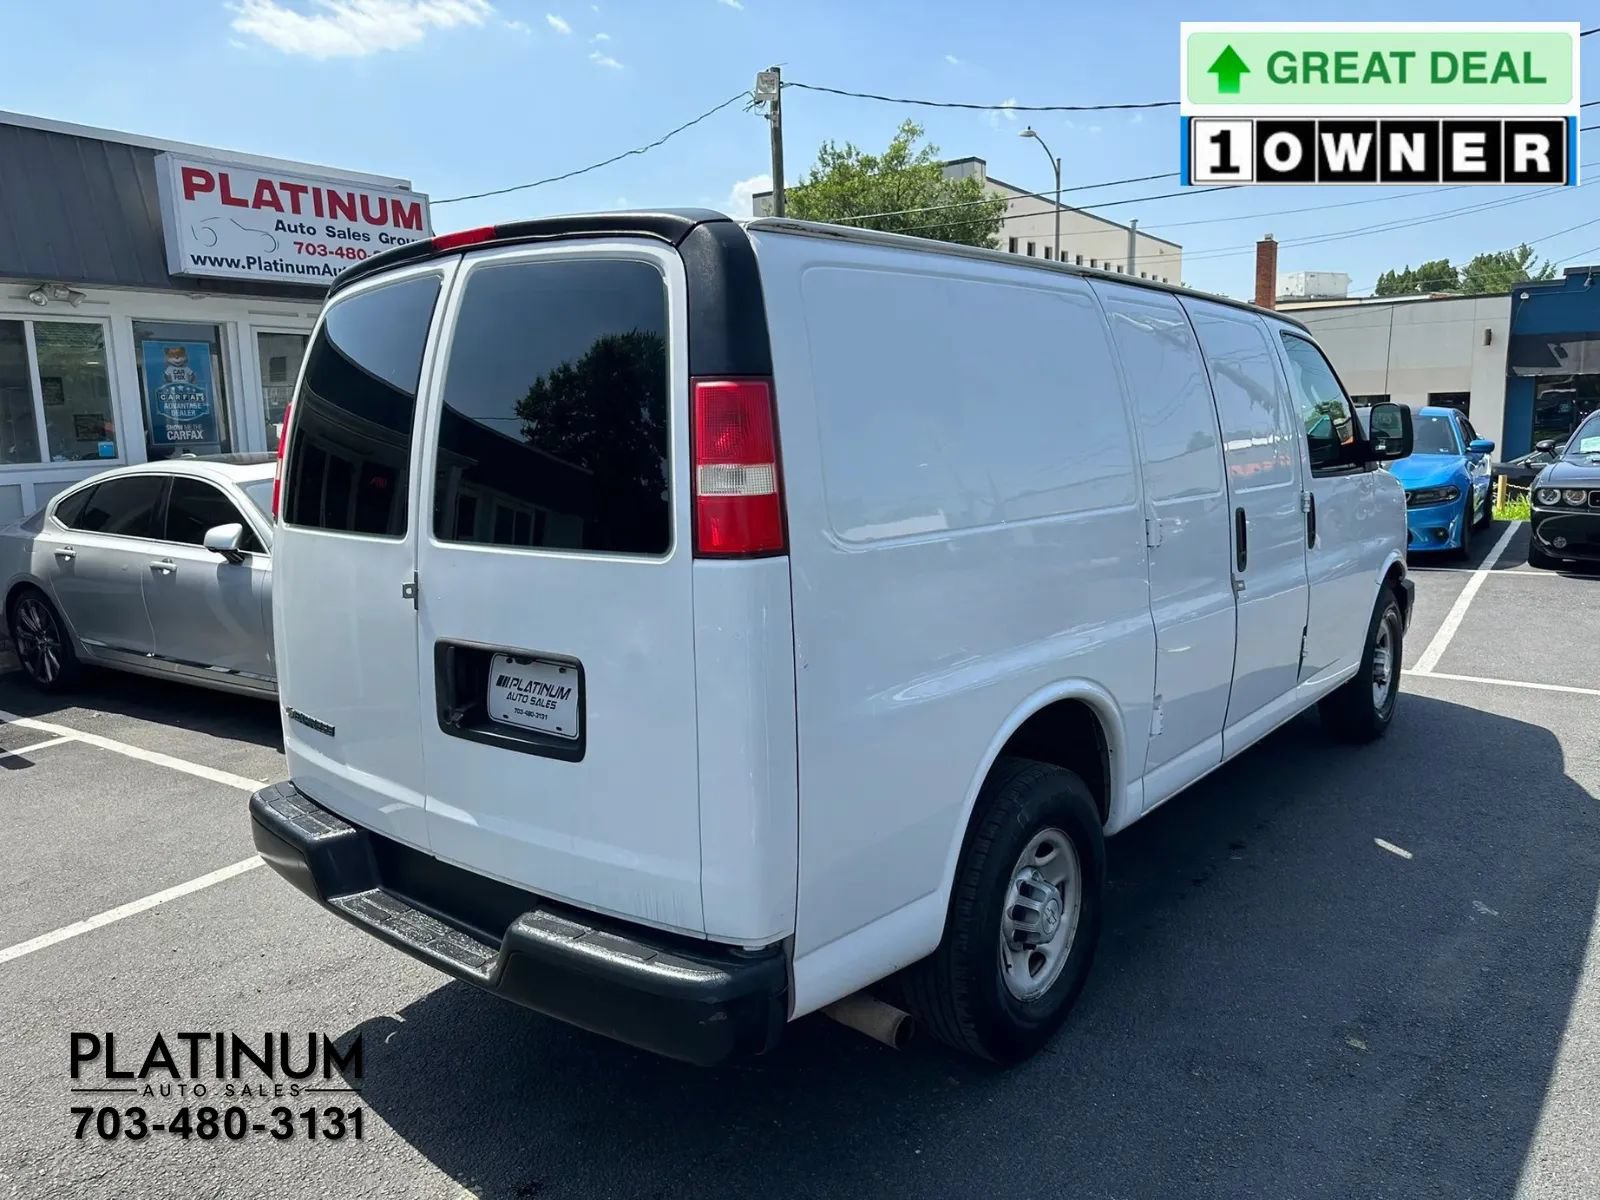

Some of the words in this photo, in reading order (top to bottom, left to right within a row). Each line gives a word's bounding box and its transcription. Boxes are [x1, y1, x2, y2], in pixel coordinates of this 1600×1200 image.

[181, 166, 424, 231] PLATINUM
[274, 218, 317, 236] Auto
[325, 225, 371, 242] Sales
[171, 409, 197, 417] DEALER
[166, 430, 204, 441] CARFAX
[508, 677, 572, 701] PLATINUM
[506, 692, 529, 704] AUTO
[530, 697, 558, 710] SALES
